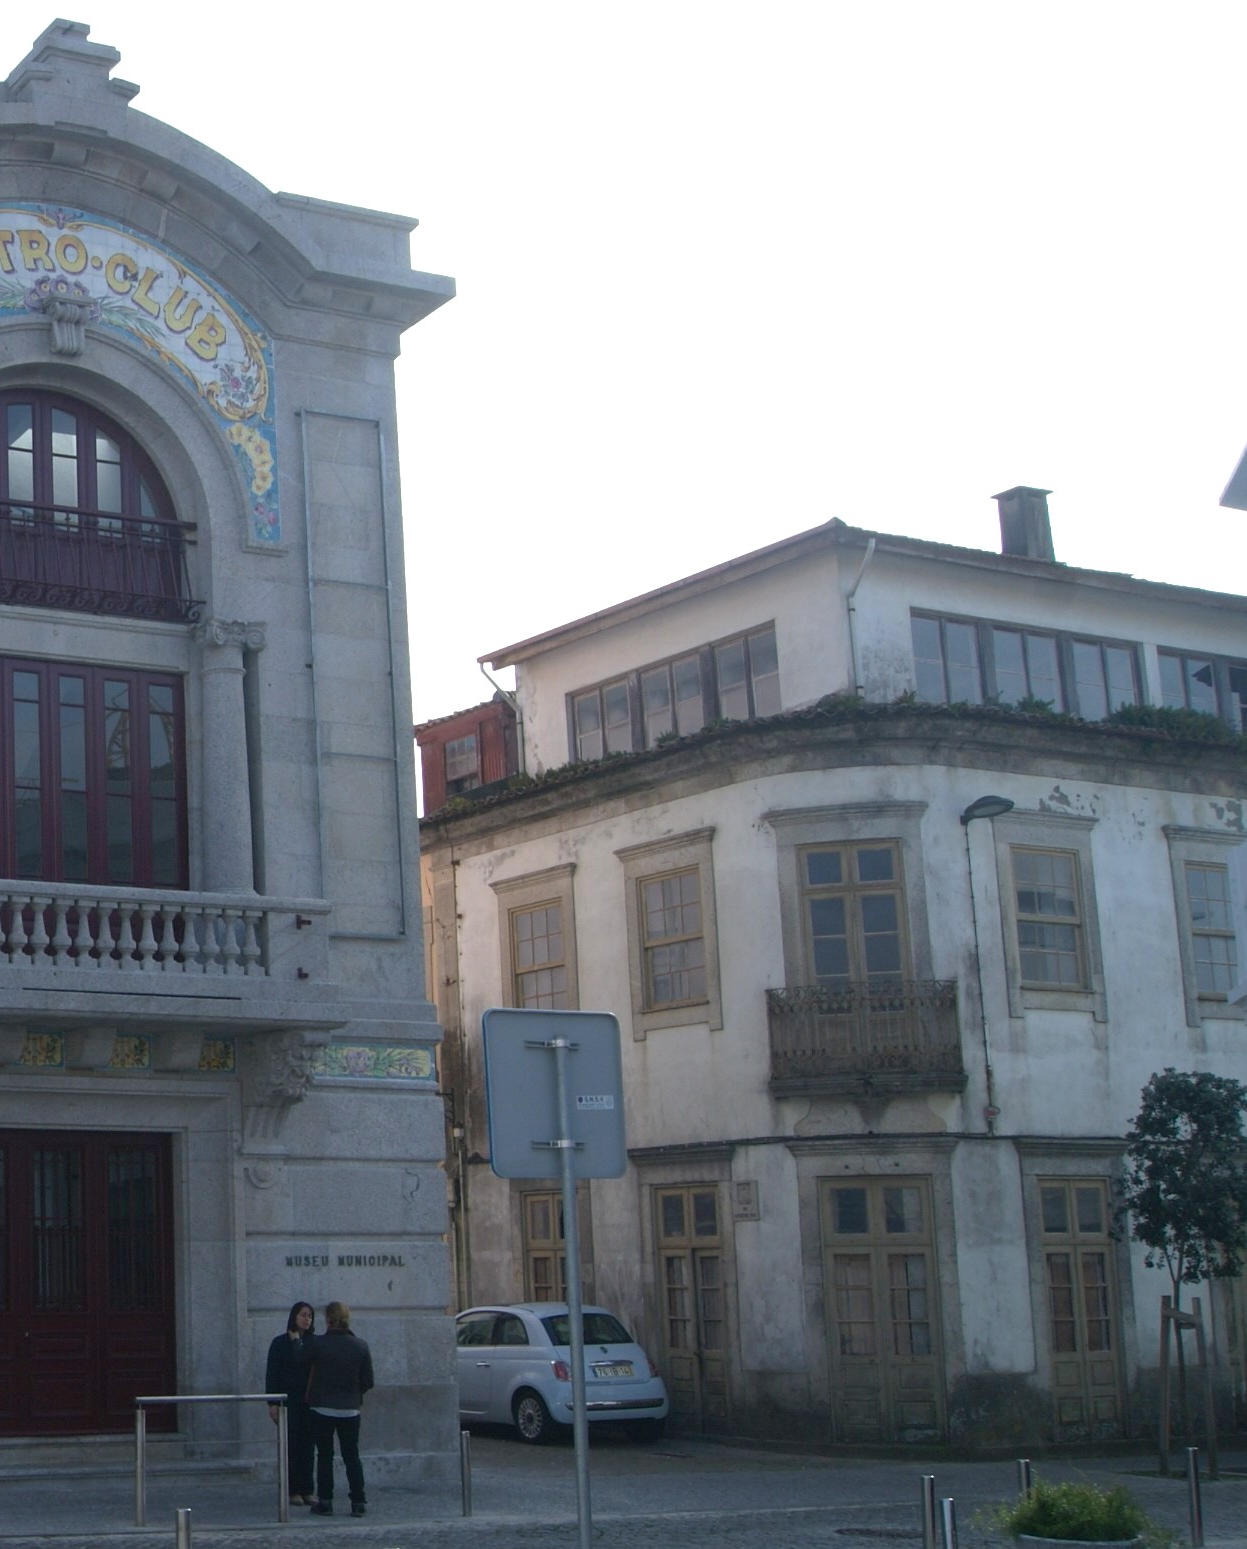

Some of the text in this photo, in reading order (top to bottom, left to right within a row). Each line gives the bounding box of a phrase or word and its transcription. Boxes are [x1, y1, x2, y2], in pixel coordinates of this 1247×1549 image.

[105, 252, 228, 362] CLUB
[285, 1255, 406, 1267] MUSEU MUNICIPAL
